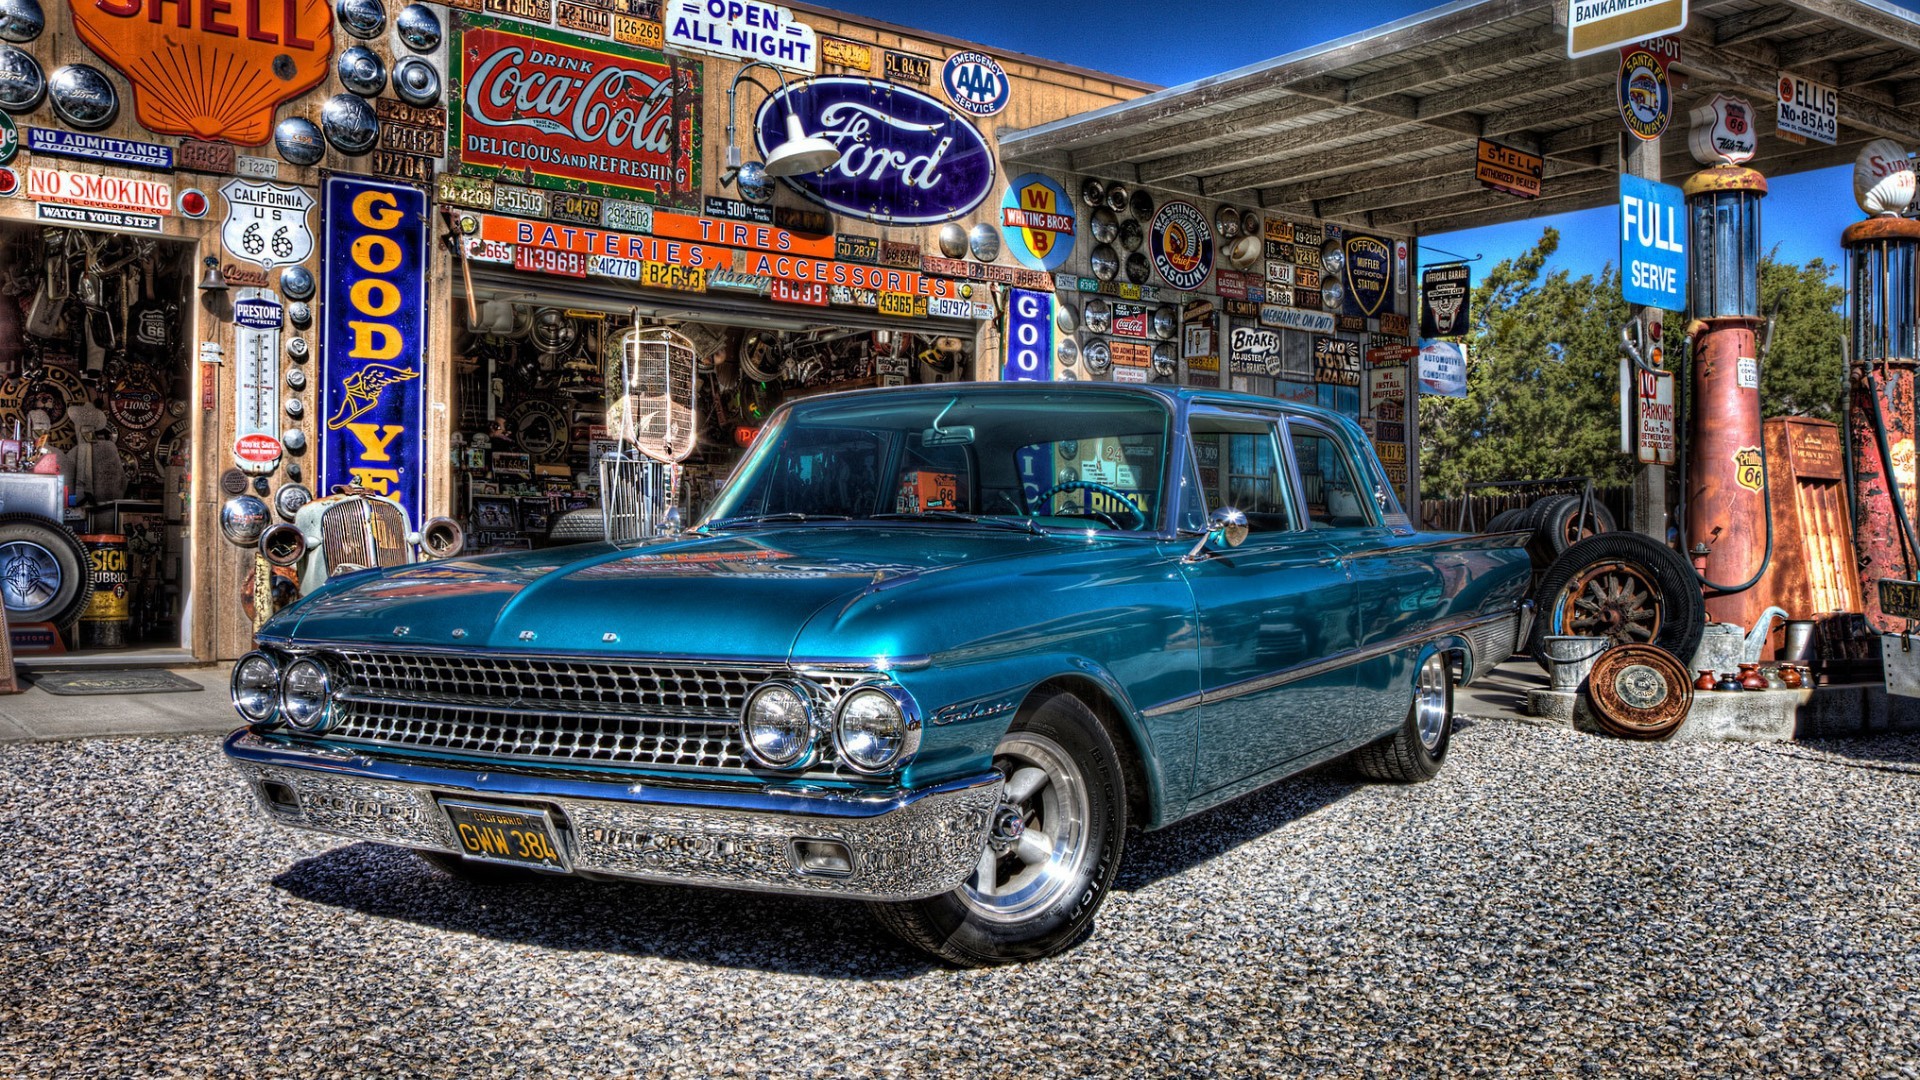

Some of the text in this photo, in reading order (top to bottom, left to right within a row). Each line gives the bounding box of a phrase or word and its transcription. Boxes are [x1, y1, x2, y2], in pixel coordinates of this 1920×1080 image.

[707, 0, 780, 32] OPEN
[673, 18, 722, 46] ALL
[732, 30, 811, 64] NIGHT
[528, 50, 594, 74] DRINK
[952, 52, 1002, 76] EMERGENCY
[1627, 55, 1664, 83] SANTA FE
[957, 64, 996, 102] AAA
[465, 46, 688, 153] Coca-Cola
[954, 94, 995, 113] SERVICE
[1796, 79, 1836, 117] ELLIS
[1623, 102, 1666, 134] TRAILWAYS
[1730, 118, 1744, 132] 66
[33, 129, 168, 158] NO ADMITTANCE
[40, 143, 85, 154] APPLY
[114, 153, 162, 164] OFFICE
[812, 102, 953, 190] Ford
[468, 135, 561, 164] DELICIOUS
[562, 152, 587, 168] AND
[589, 154, 687, 183] REFRESHING
[1488, 148, 1533, 170] SHELL
[31, 169, 170, 207] NO SMOKING
[1481, 166, 1538, 190] AUTHORIZED DEALER
[84, 200, 147, 212] DEVELOPMENT
[234, 188, 303, 208] CALIFORNIA
[566, 198, 598, 217] 0479
[710, 199, 746, 217] Law 500
[1027, 189, 1049, 209] W
[42, 207, 157, 228] WATCH YOUR STEP
[754, 213, 770, 221] Trucks
[1006, 208, 1045, 227] WHITING
[1154, 204, 1211, 241] WASHINGTON
[1622, 194, 1684, 253] FULL
[242, 222, 293, 258] 66
[517, 222, 704, 266] BATTERIES
[699, 220, 791, 250] TIRES
[1033, 231, 1048, 251] B
[523, 247, 578, 273] 113968
[853, 244, 876, 259] 2837
[1350, 241, 1387, 260] OFFICIAL
[599, 257, 637, 278] 412778
[1156, 255, 1208, 287] GASOLINE
[1172, 254, 1199, 270] Chief
[1357, 257, 1380, 270] MUFFLER
[706, 262, 771, 297] Liberty
[756, 255, 946, 295] ACCESSORIES
[1218, 278, 1245, 290] GASOLINE
[1357, 279, 1380, 291] STATION
[1426, 269, 1467, 283] OFFICIAL GARAGE
[1631, 259, 1677, 294] SERVE
[237, 303, 282, 319] PRESTONE
[880, 293, 912, 314] 43365
[939, 299, 971, 318] 197972
[1237, 302, 1257, 315] SMITH
[1262, 309, 1334, 331] MECHANIC ON DUTY
[147, 327, 165, 336] 66
[1017, 296, 1039, 381] GOO
[1234, 330, 1278, 351] BRAKES
[1329, 341, 1345, 354] NO
[1315, 352, 1360, 371] TOOLS
[1438, 364, 1448, 372] AIR
[1315, 368, 1360, 386] LOANED
[1376, 380, 1400, 390] INSTALL
[1383, 372, 1393, 380] WE
[1641, 373, 1656, 398] NO
[1372, 390, 1404, 399] MUFFLERS
[124, 401, 152, 411] LIONS
[1641, 402, 1672, 421] PARKING
[121, 410, 138, 423] DRAG
[138, 411, 154, 423] STRIP
[1644, 421, 1664, 433] 8 5
[241, 440, 260, 449] YOU'RE
[1107, 446, 1122, 462] 24
[1647, 441, 1663, 449] SCHOOL
[1744, 467, 1762, 487] 66
[940, 488, 953, 501] 66
[932, 699, 1017, 727] Galaxie
[473, 812, 524, 826] CALIFORNIA
[458, 823, 558, 862] GWW 384
